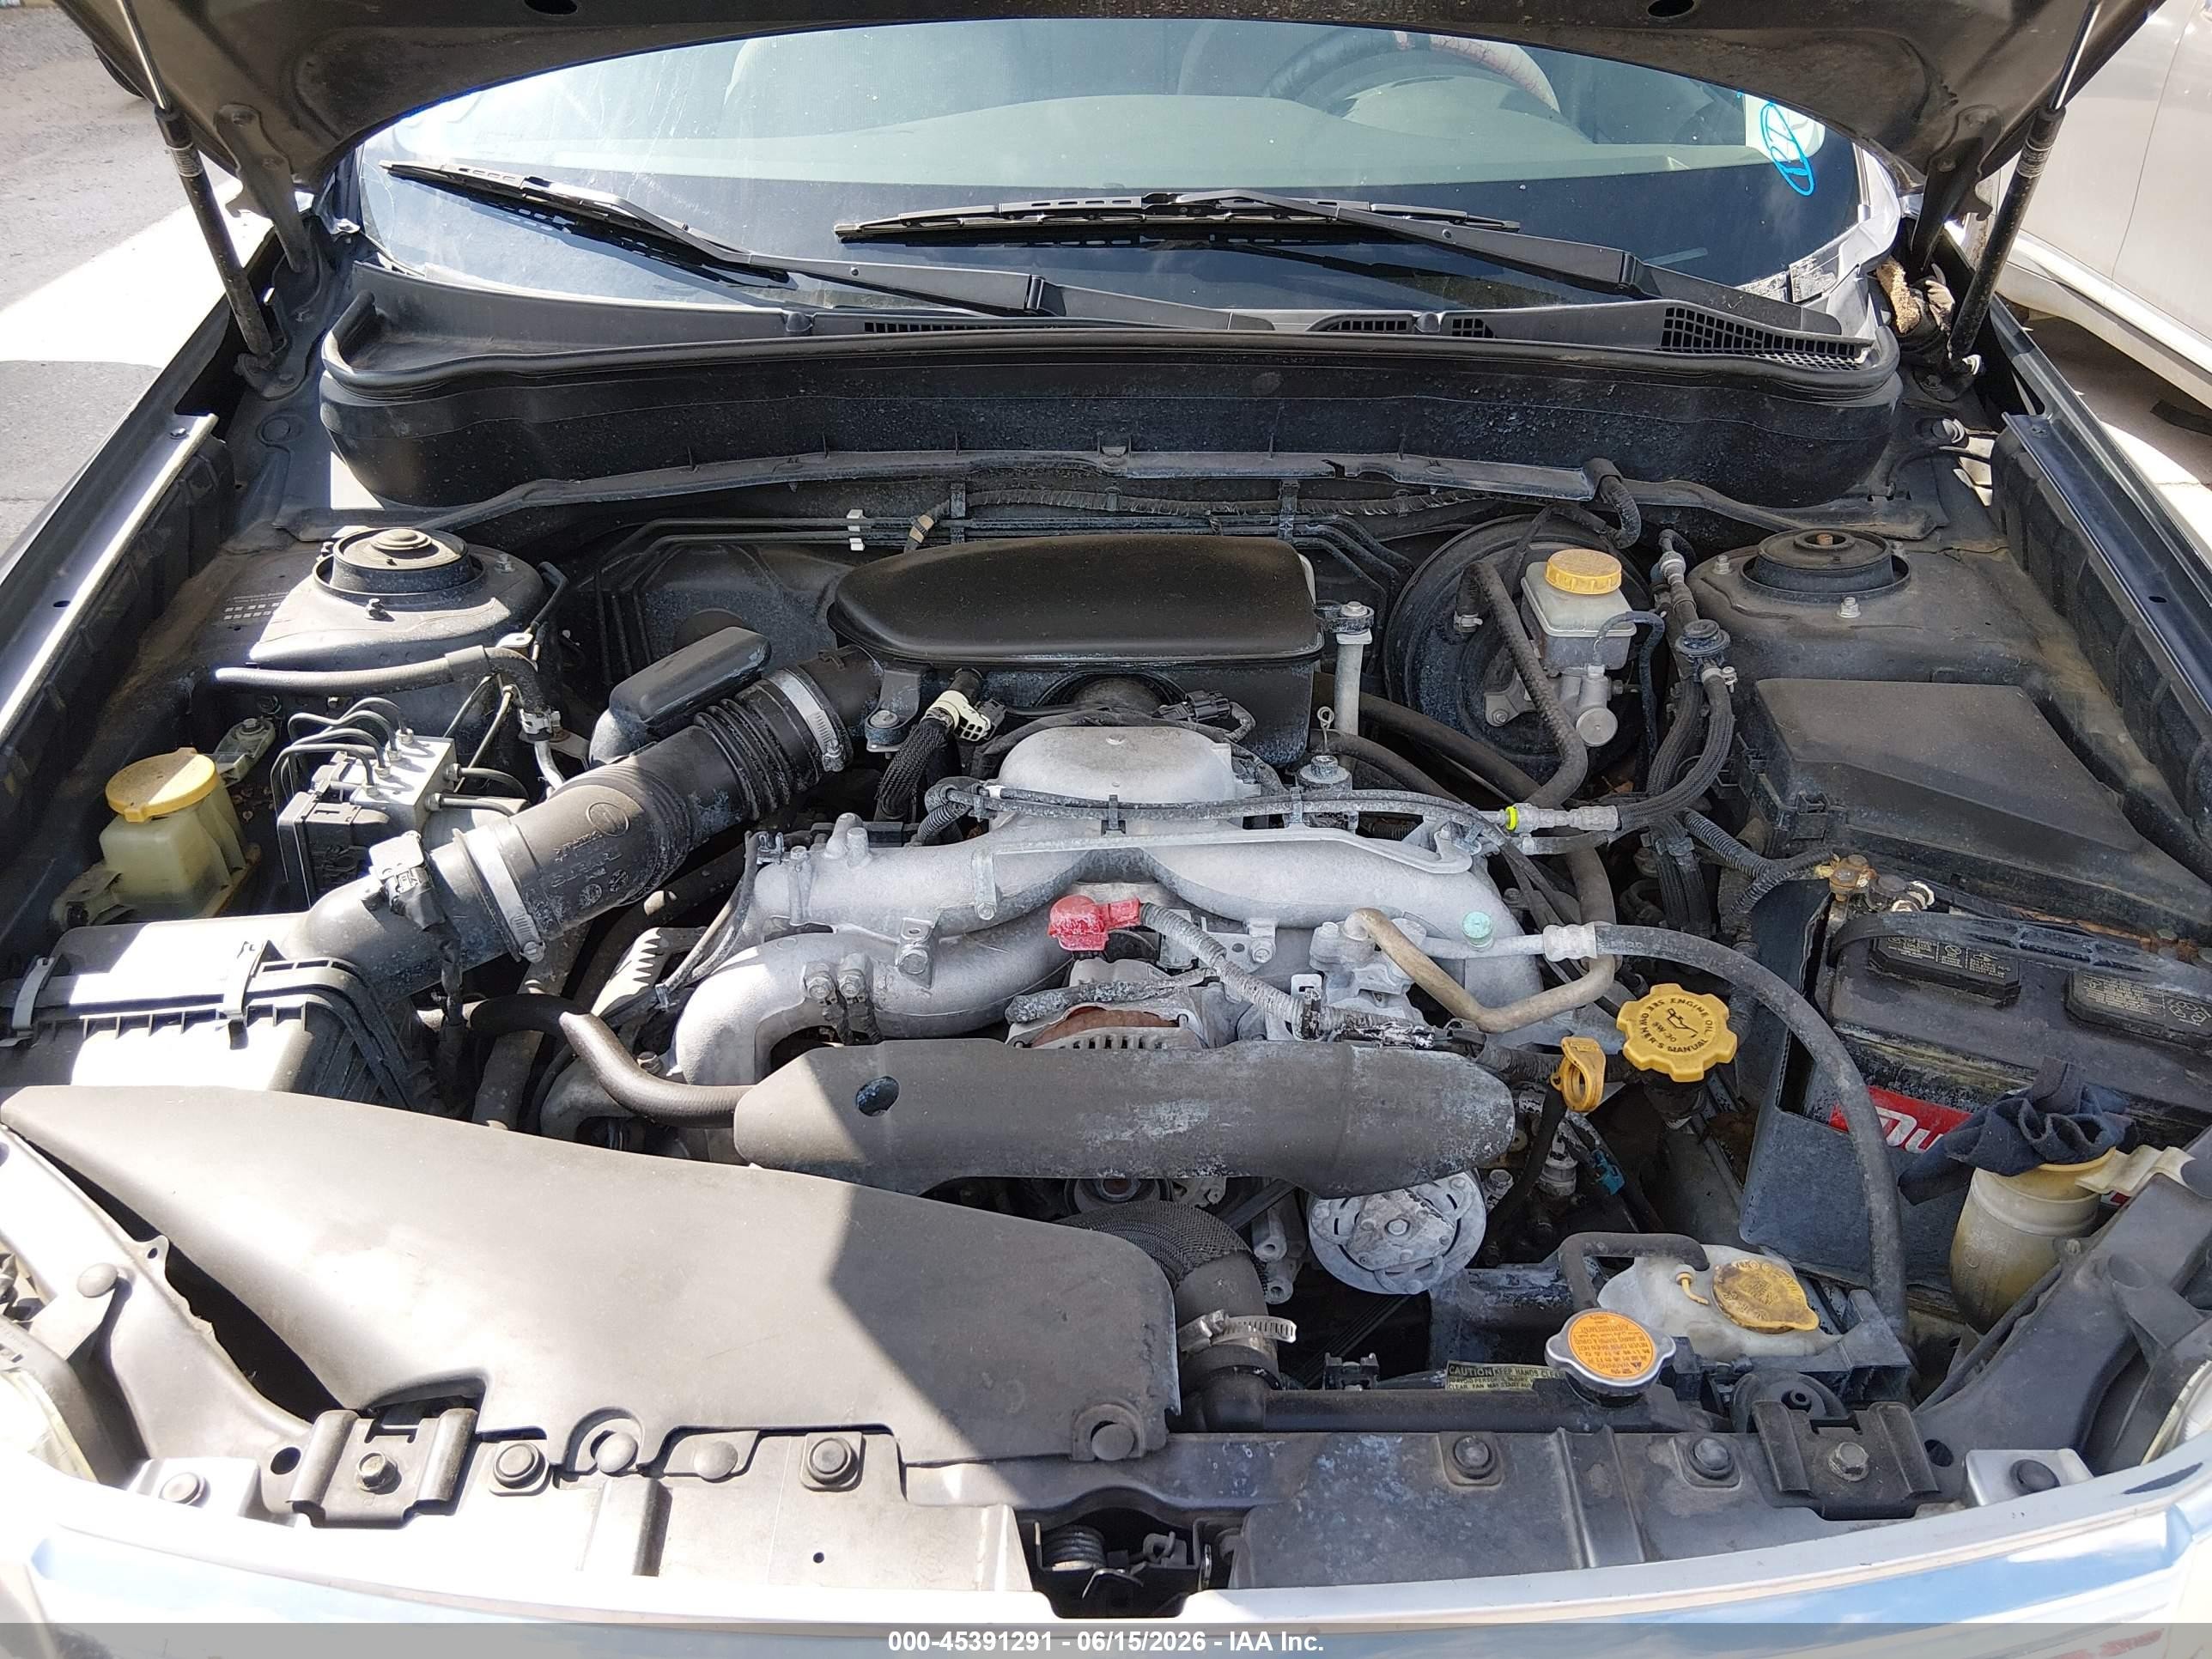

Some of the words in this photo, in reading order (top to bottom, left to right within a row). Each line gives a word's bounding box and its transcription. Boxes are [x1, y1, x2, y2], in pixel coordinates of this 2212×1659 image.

[1647, 999, 1665, 1012] SEE
[1670, 998, 1710, 1018] ENGINE
[1705, 1019, 1714, 1036] OIL
[1640, 1012, 1665, 1049] OWNER'S
[1668, 1038, 1709, 1053] MANUAL
[1449, 1365, 1495, 1376] CAUTION
[1516, 1367, 1539, 1376] HANDS
